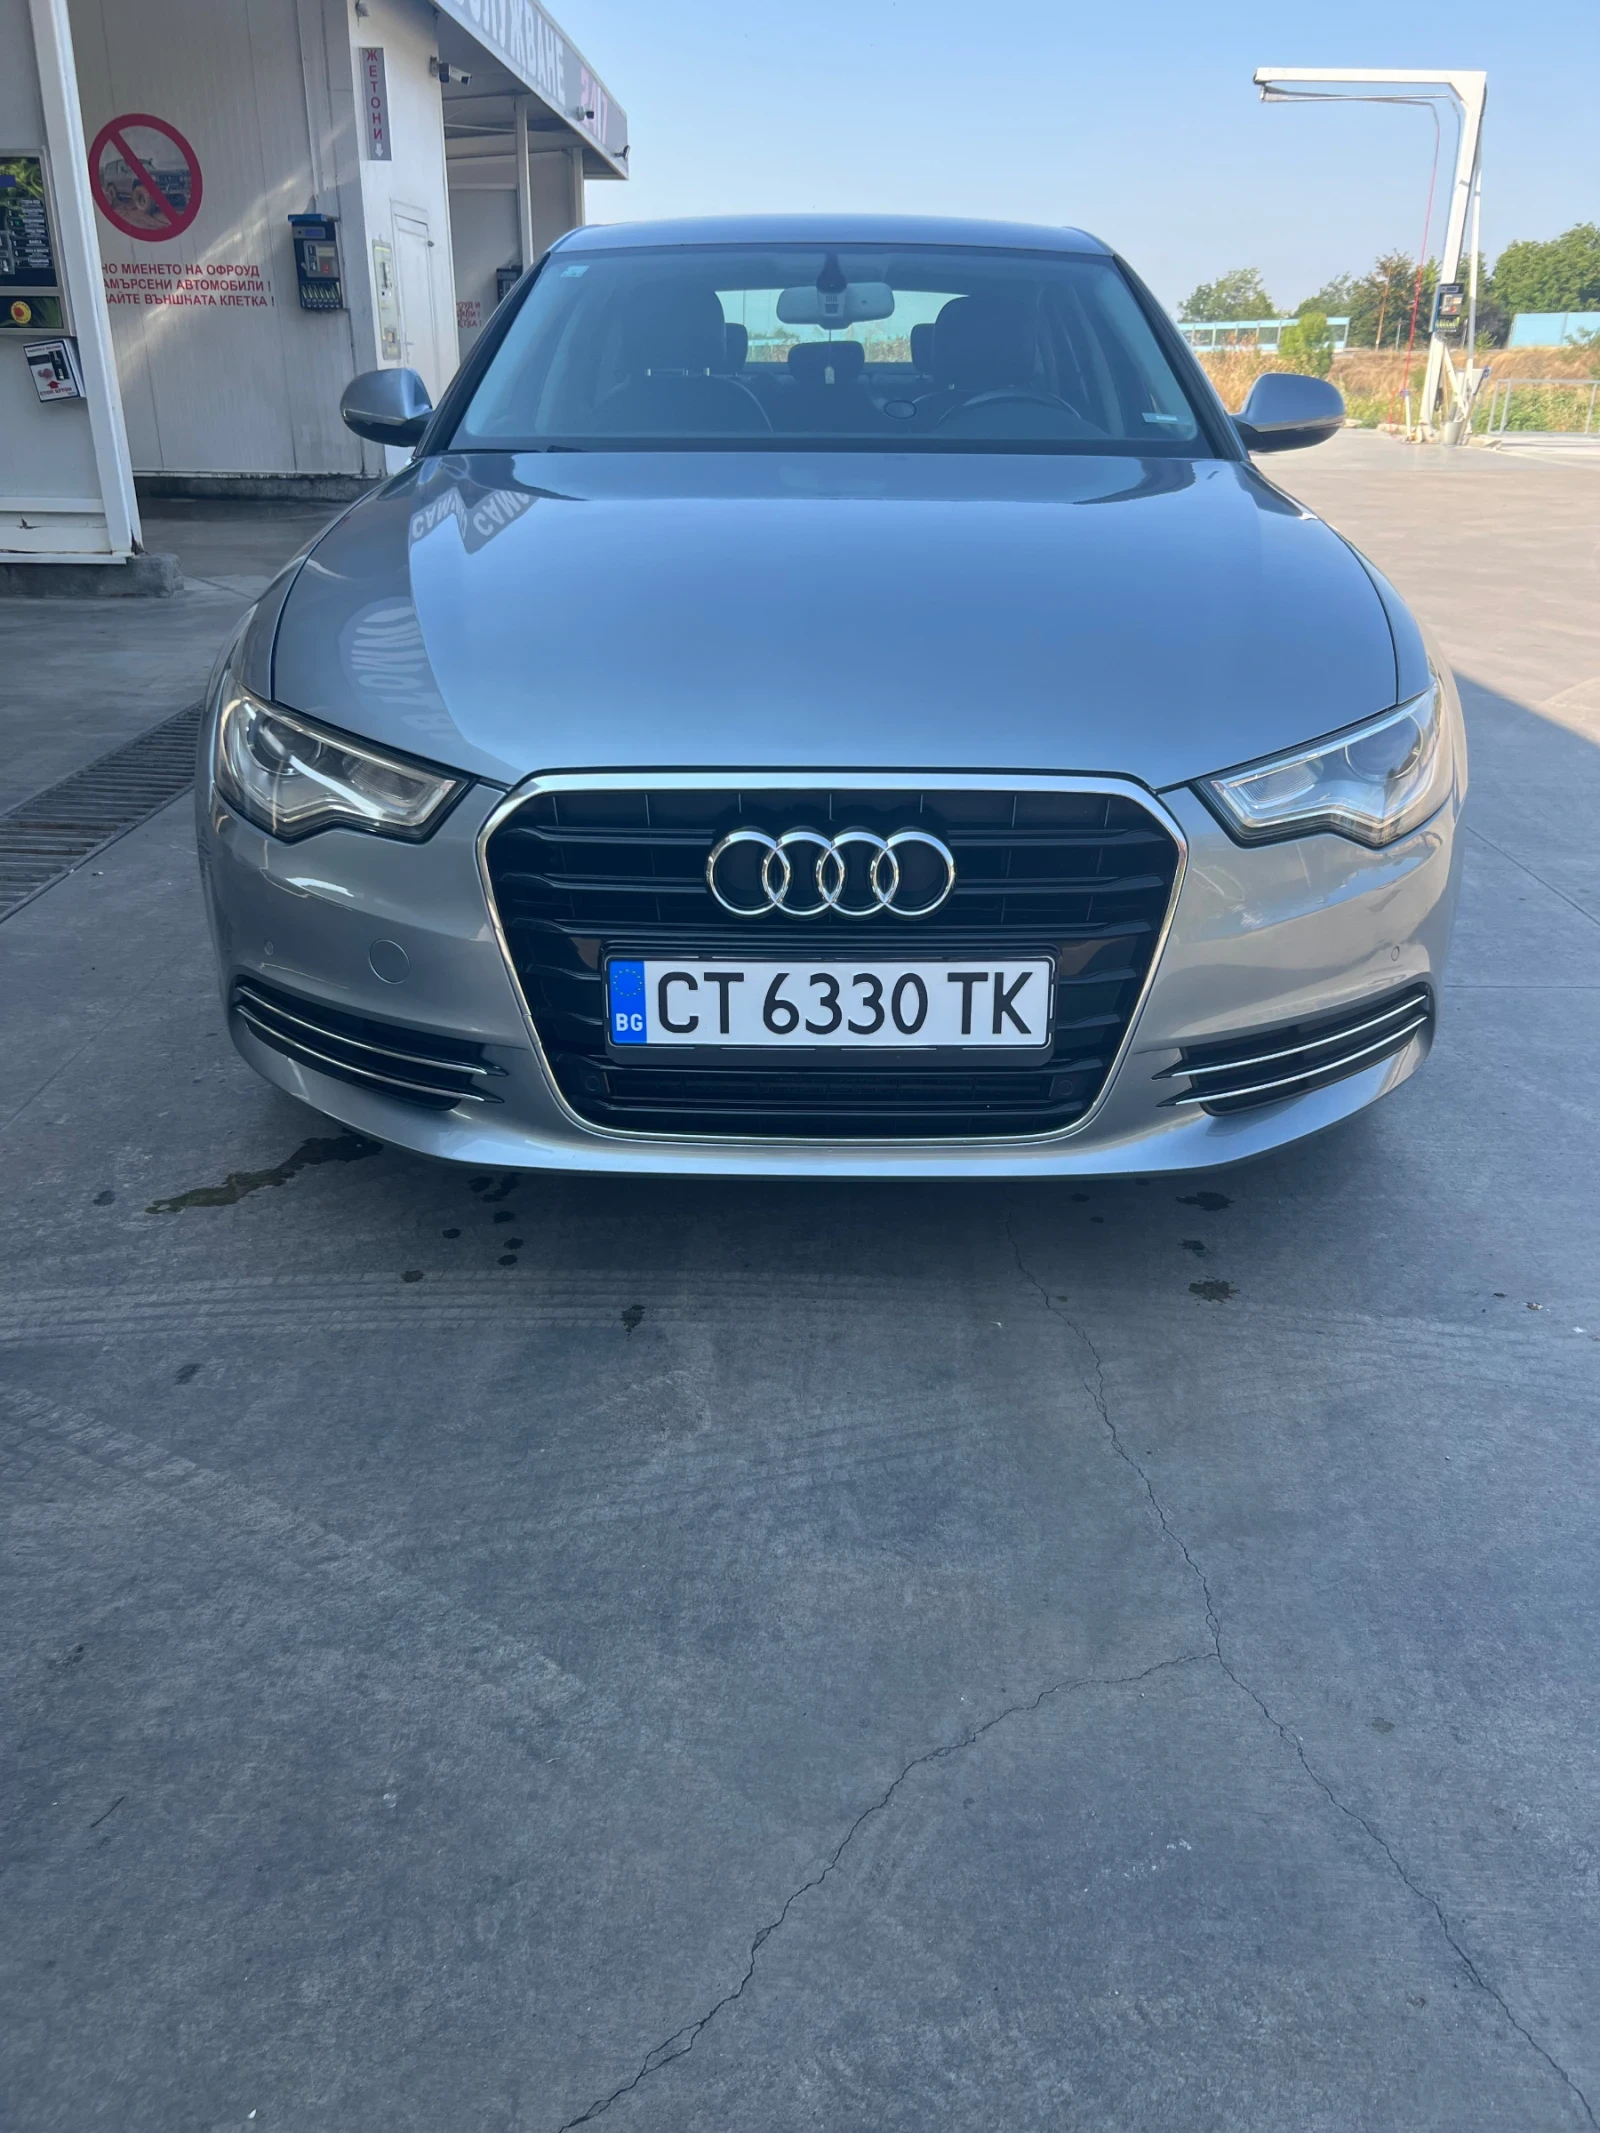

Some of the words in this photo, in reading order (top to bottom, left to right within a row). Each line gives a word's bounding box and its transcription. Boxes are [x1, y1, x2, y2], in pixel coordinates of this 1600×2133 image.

[452, 0, 566, 107] ЛУЖВАНЕ
[366, 49, 382, 140] ЖЕТОНИ
[121, 263, 182, 275] МИЕНЕТО
[185, 264, 203, 275] НА
[206, 264, 260, 278] ОФРОУД
[176, 279, 264, 292] АВТОМОБИЛИ
[145, 294, 217, 306] ВЪНШНАТА
[220, 295, 268, 307] КЛЕТКА
[658, 971, 745, 1035] CT
[762, 972, 929, 1035] 6330
[947, 971, 1034, 1035] TK
[615, 1013, 643, 1032] BG
